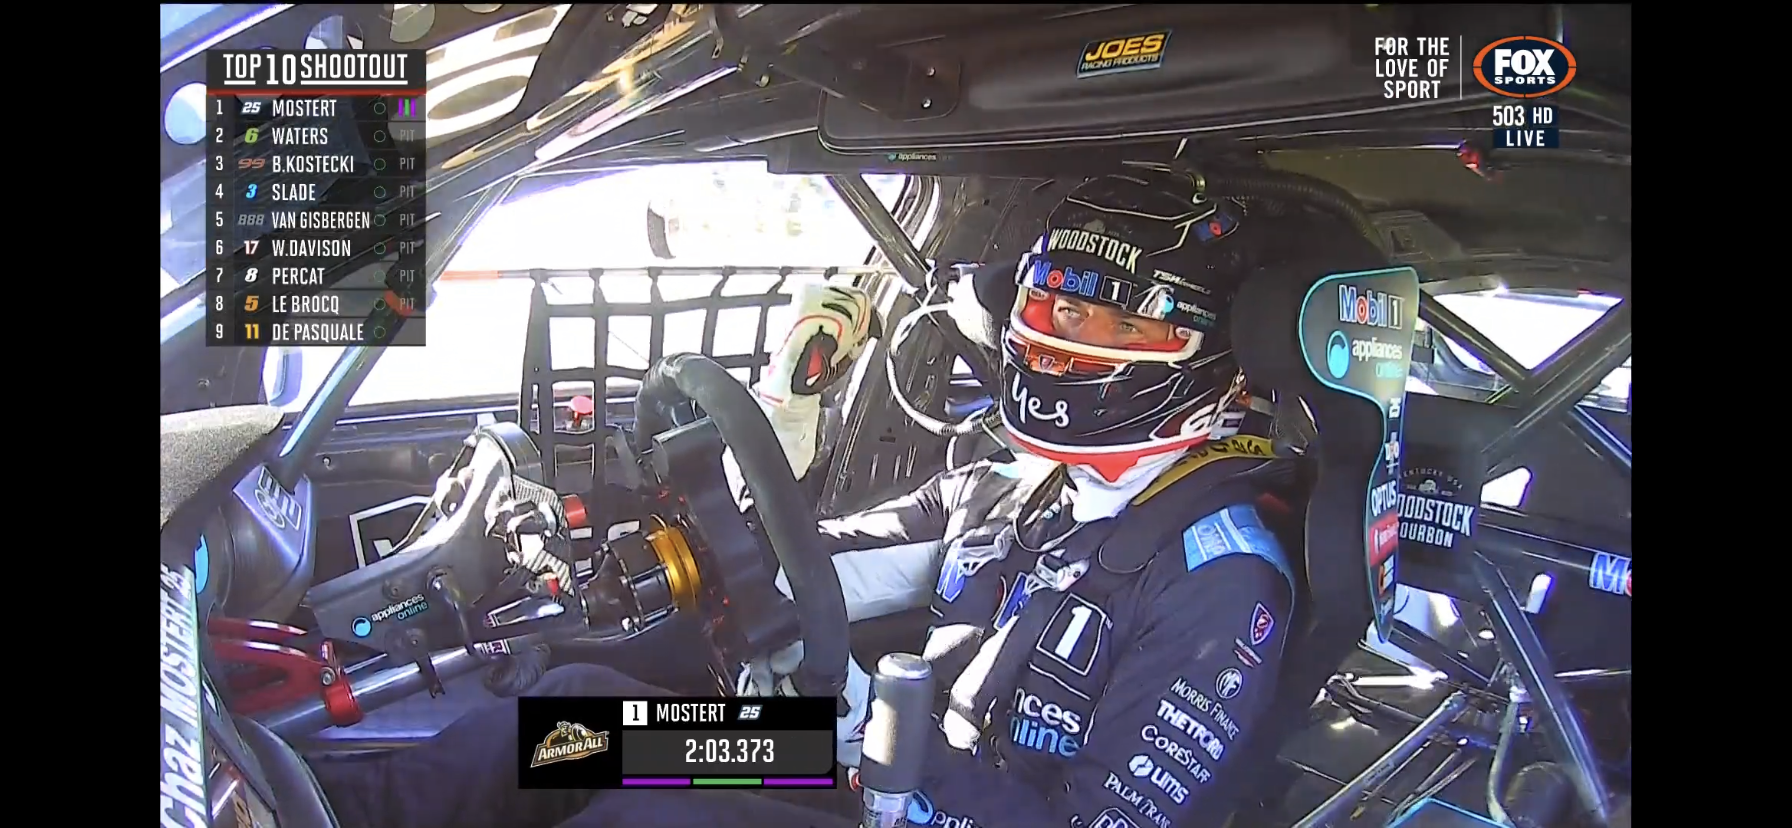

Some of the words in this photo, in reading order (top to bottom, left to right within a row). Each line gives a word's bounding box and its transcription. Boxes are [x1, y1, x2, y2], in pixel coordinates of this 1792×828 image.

[1081, 60, 1112, 71] RACING
[1113, 54, 1159, 67] PRODUCTS
[1085, 33, 1165, 62] JOES
[1048, 227, 1142, 274] WOODSTOCK
[1032, 260, 1099, 297] Mobil
[1339, 284, 1388, 327] Mobil
[1352, 336, 1403, 362] appliances
[1371, 480, 1397, 516] OPTUS
[1397, 493, 1475, 537] OODSTOCK
[1398, 521, 1454, 548] OURBON
[372, 593, 425, 621] appliances
[397, 601, 428, 620] online
[1013, 686, 1081, 734] nces
[1171, 677, 1212, 712] MORRIS
[1010, 716, 1081, 757] nline
[1156, 699, 1225, 761] THETFORD
[1103, 772, 1144, 810] PALM
